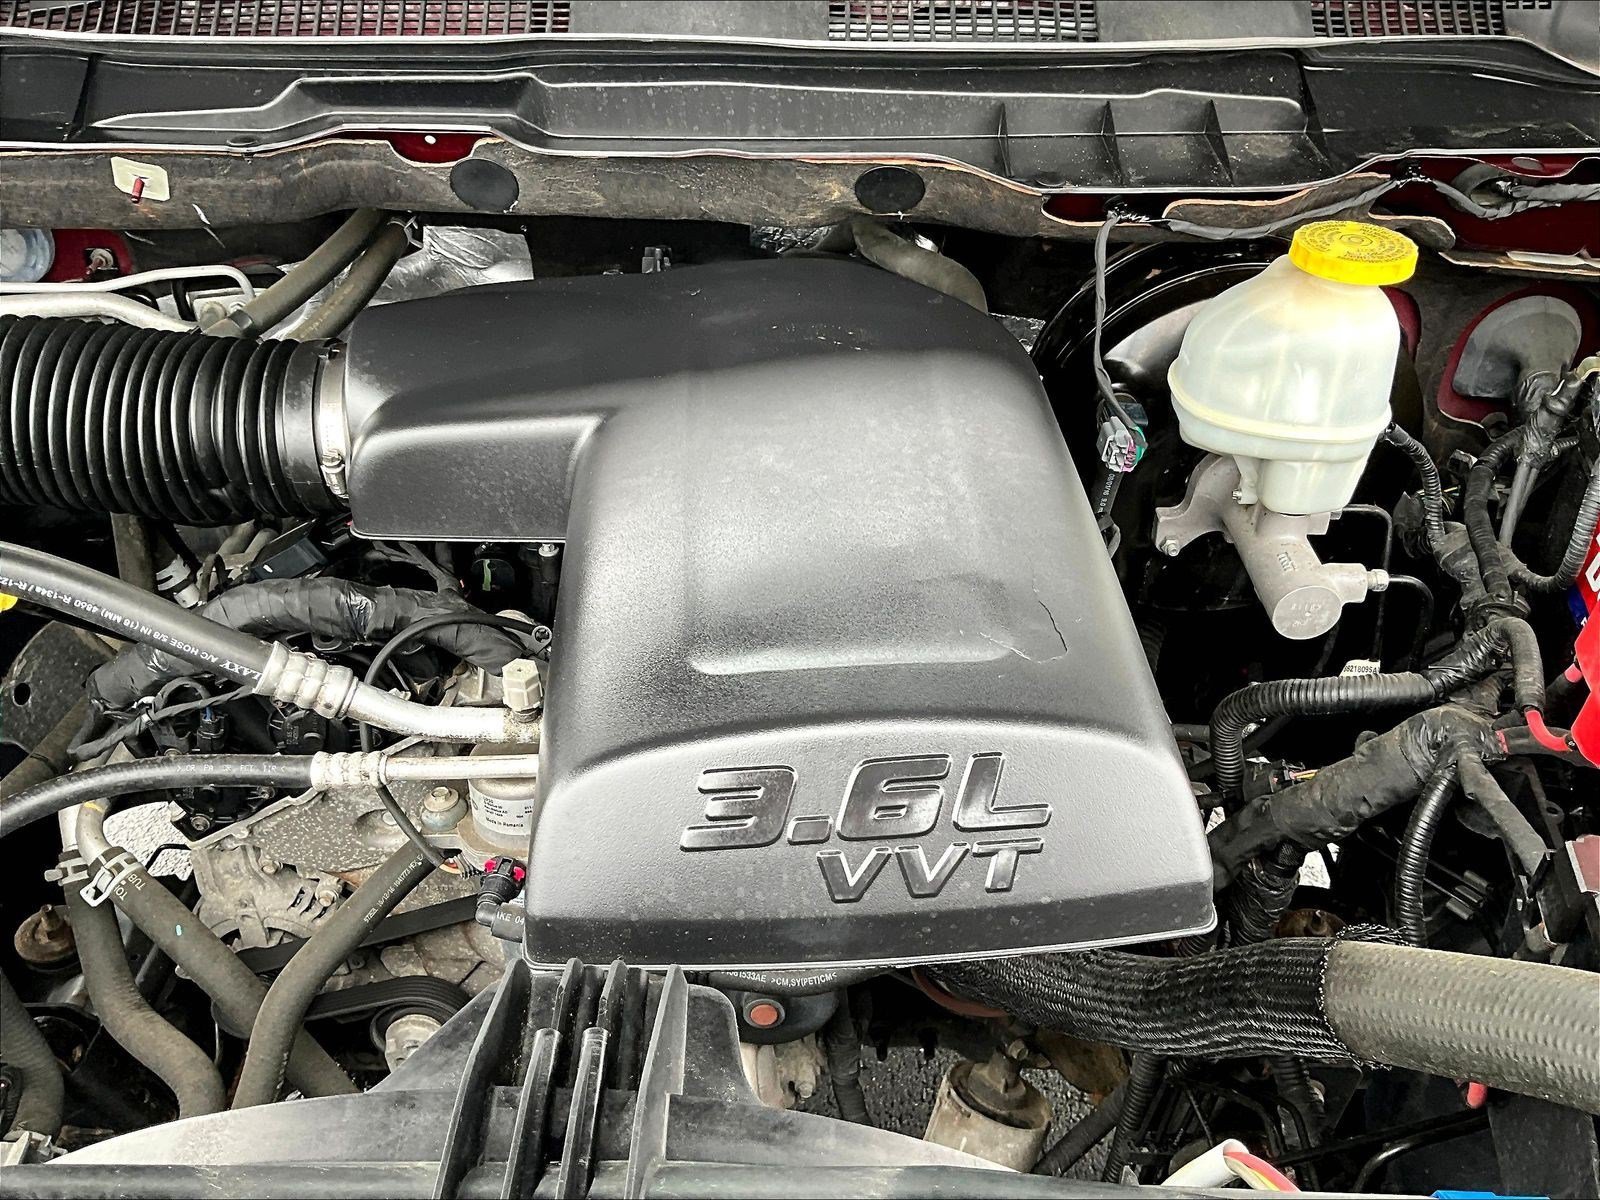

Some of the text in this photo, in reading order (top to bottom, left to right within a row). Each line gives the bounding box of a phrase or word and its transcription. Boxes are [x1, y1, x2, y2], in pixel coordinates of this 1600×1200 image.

[35, 586, 72, 604] R-134a
[73, 599, 98, 613] 4860
[100, 609, 122, 623] MM)
[140, 626, 152, 636] IN
[153, 631, 169, 642] 5/8
[169, 637, 199, 656] HOSE
[199, 651, 219, 663] A/C
[679, 751, 1053, 852] 3.6L
[816, 836, 1045, 904] VVT
[113, 884, 128, 901] TO
